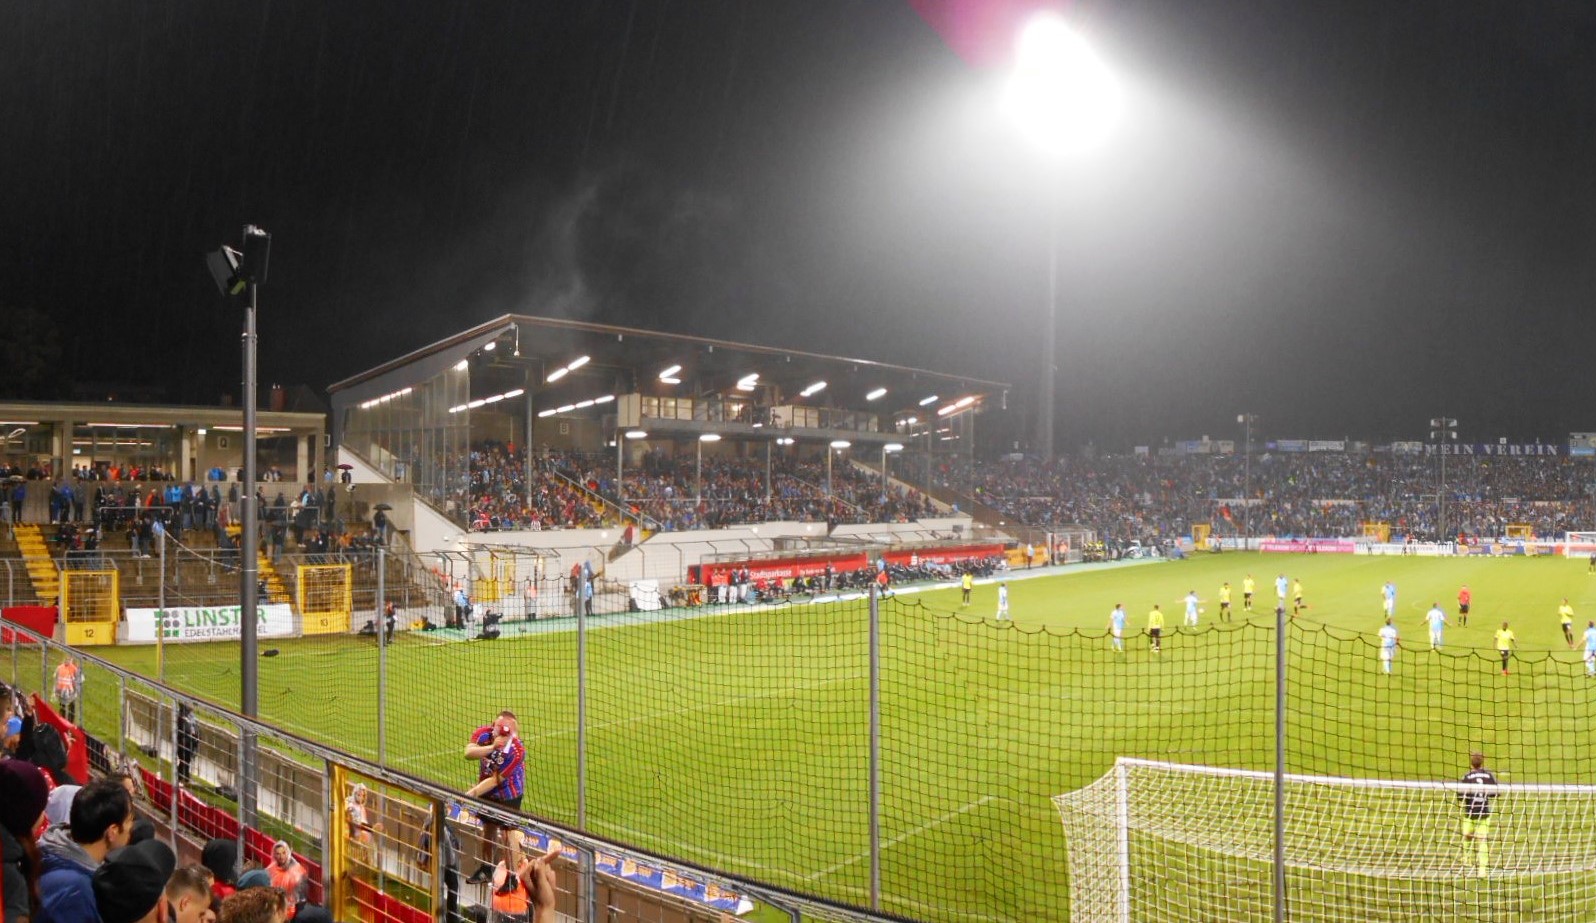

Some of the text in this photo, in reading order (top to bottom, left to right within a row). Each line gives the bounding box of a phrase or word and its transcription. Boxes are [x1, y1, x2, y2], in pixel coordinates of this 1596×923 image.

[1425, 443, 1558, 456] MEIN VEREIN
[184, 607, 267, 627] LINSTR
[84, 629, 94, 638] 12
